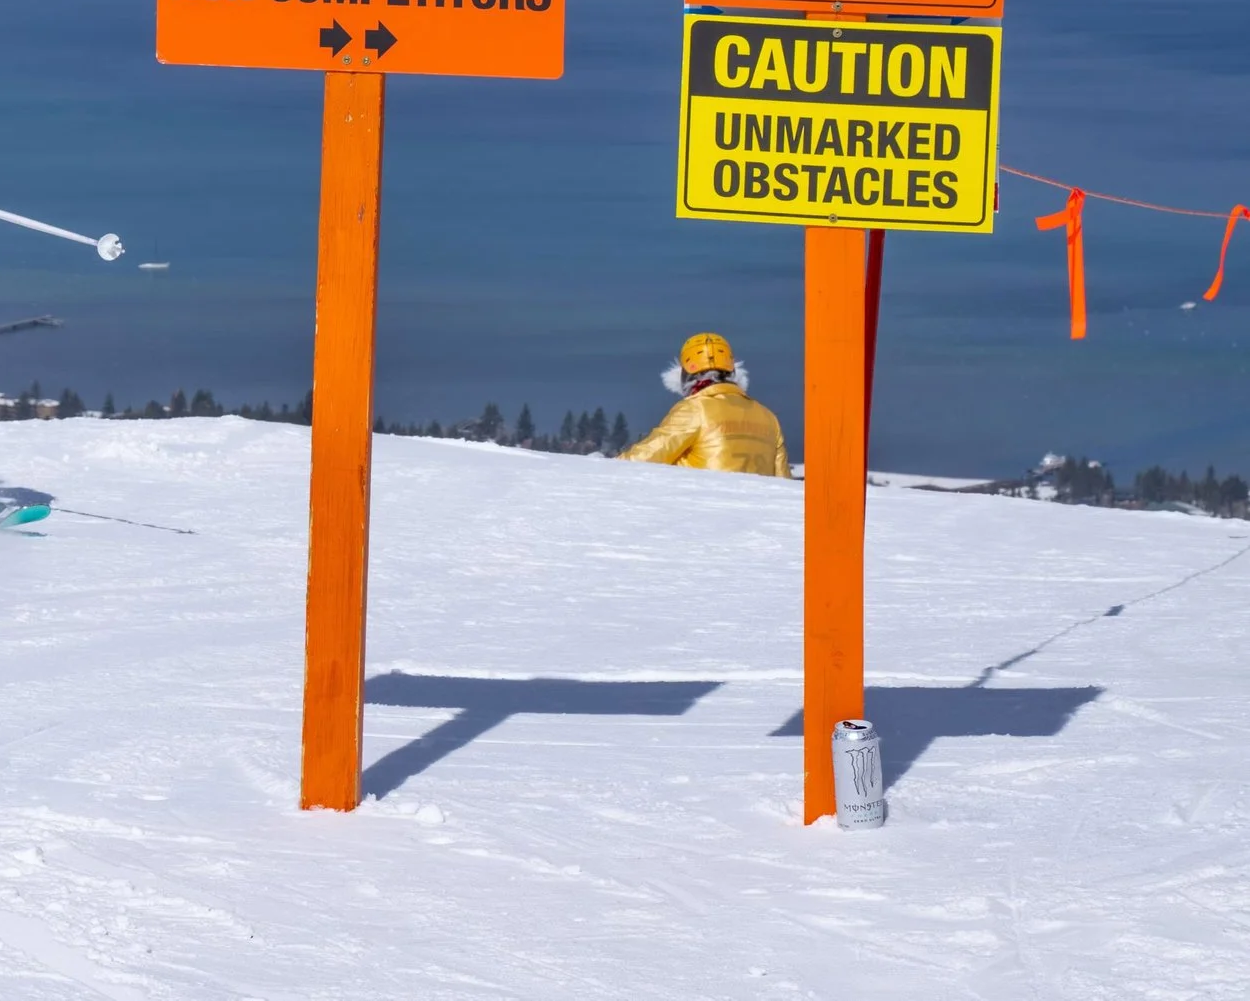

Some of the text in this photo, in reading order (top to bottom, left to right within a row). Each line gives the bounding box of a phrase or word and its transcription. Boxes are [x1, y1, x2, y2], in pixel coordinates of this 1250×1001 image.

[713, 35, 968, 99] CAUTION
[714, 111, 961, 162] UNMARKED
[713, 159, 959, 209] OBSTACLES
